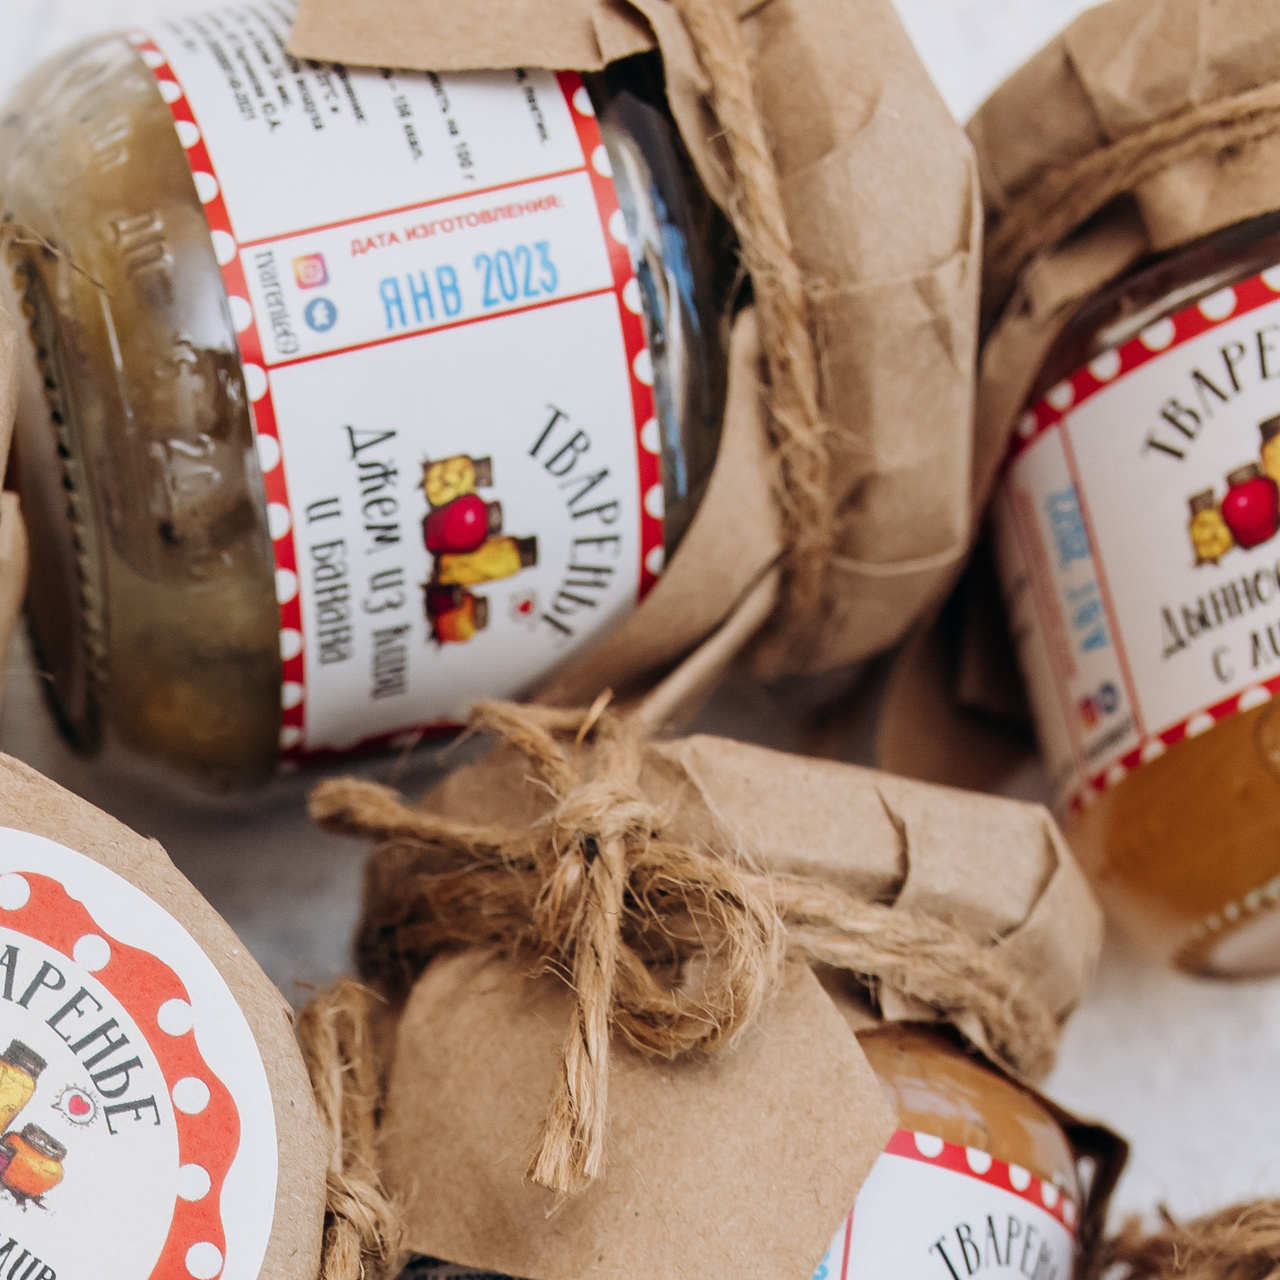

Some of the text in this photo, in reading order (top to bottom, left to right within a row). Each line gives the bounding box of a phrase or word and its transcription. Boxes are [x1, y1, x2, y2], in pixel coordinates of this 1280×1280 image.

[350, 231, 401, 257] ДАТА
[378, 240, 559, 331] ЯНВ 2023
[304, 496, 343, 525] и
[344, 424, 403, 555] Джем
[1159, 563, 1280, 661] Дынно
